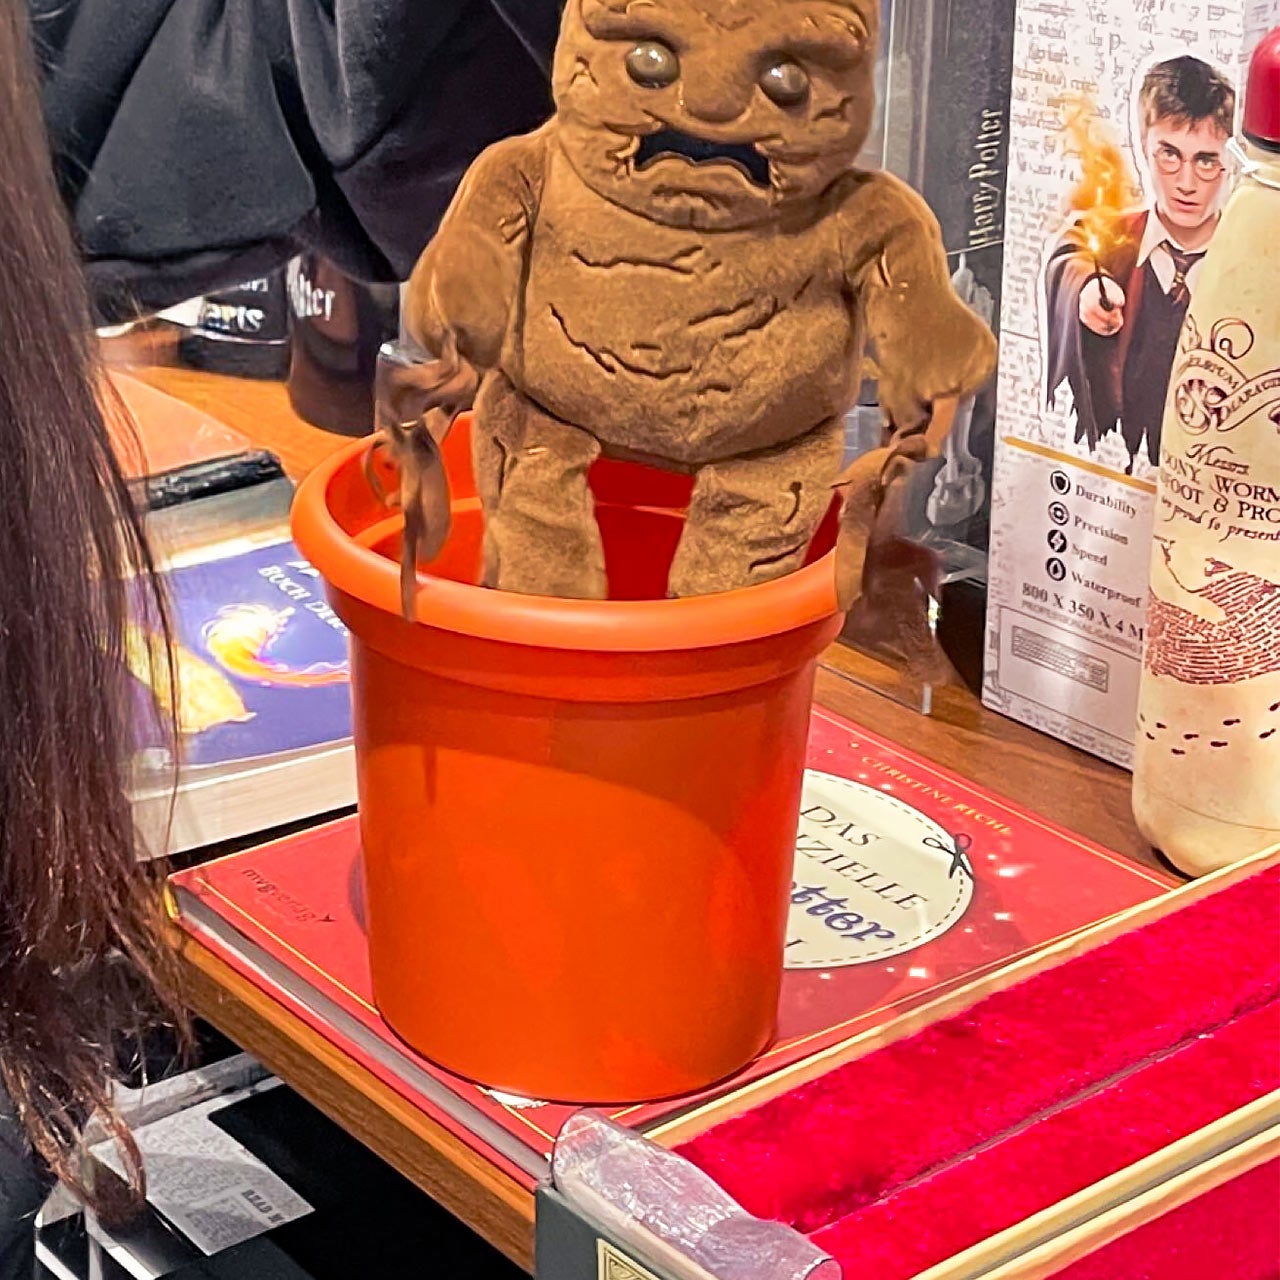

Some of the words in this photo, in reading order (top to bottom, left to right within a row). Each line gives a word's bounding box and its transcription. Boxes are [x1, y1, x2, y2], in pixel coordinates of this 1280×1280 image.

[968, 108, 1003, 180] Potter
[969, 182, 1003, 246] Harry
[1075, 484, 1137, 518] Durability
[1074, 515, 1128, 545] Precision
[1072, 543, 1108, 566] Speed
[1022, 582, 1048, 602] 800
[1069, 600, 1095, 621] 350
[1071, 570, 1142, 608] Waterproof
[800, 805, 882, 846] DAS
